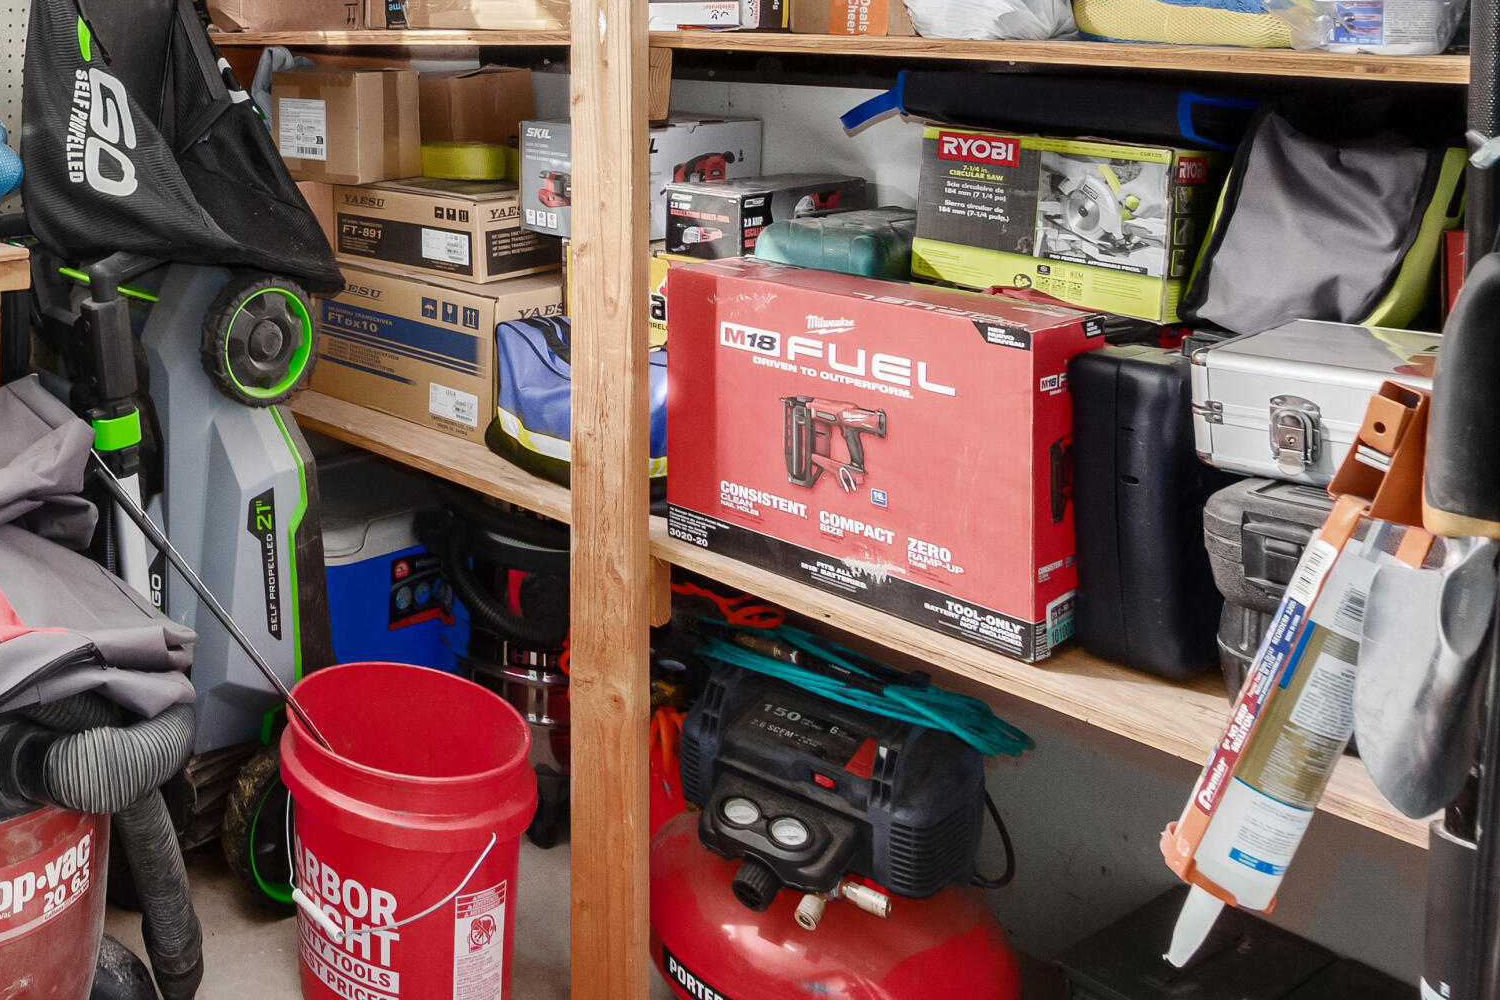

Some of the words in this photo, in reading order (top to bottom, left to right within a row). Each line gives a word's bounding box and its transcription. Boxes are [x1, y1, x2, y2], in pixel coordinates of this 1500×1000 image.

[73, 69, 89, 110] SELF
[65, 107, 89, 184] PROPELLED
[525, 127, 552, 139] SKIL
[942, 135, 1015, 162] RYOBI
[949, 169, 985, 180] CIRCULAR
[343, 193, 386, 208] YAESU
[342, 223, 383, 240] FT-891
[347, 283, 382, 299] ESU
[805, 313, 857, 331] Milwaukee
[987, 326, 1007, 335] NEW
[724, 326, 777, 352] M18
[987, 331, 1015, 342] NUEVO
[987, 336, 1026, 349] NOUVEAU
[752, 355, 798, 374] DRIVEN
[800, 365, 818, 378] TO
[819, 371, 915, 400] OUTPERFORM.
[787, 335, 957, 397] FUEL
[720, 480, 809, 519] CONSISTENT.
[720, 493, 754, 509] CLEAN
[720, 500, 736, 509] NAIL
[736, 503, 760, 517] HOLES
[668, 527, 709, 548] 3020-20
[819, 510, 895, 545] COMPACT
[819, 523, 845, 538] SIZE
[907, 536, 952, 563] ZERO
[266, 533, 280, 600] PROPELLED
[816, 560, 835, 571] FITS
[835, 566, 853, 578] ALL
[907, 551, 965, 575] RAMP-UP
[907, 559, 929, 571] TIME
[269, 602, 280, 632] SELF
[923, 602, 960, 620] BATTERY
[960, 614, 980, 627] AND
[980, 620, 1023, 642] CHARGER
[945, 599, 1023, 635] TOOL-ONLY
[959, 620, 979, 633] NOT
[1227, 719, 1240, 738] NO
[1235, 703, 1249, 726] DRIP
[1231, 712, 1255, 754] SKELETON
[1197, 756, 1230, 811] Premier
[296, 835, 398, 930] ARBOR
[43, 883, 66, 914] 20
[331, 947, 392, 988] TOOLS
